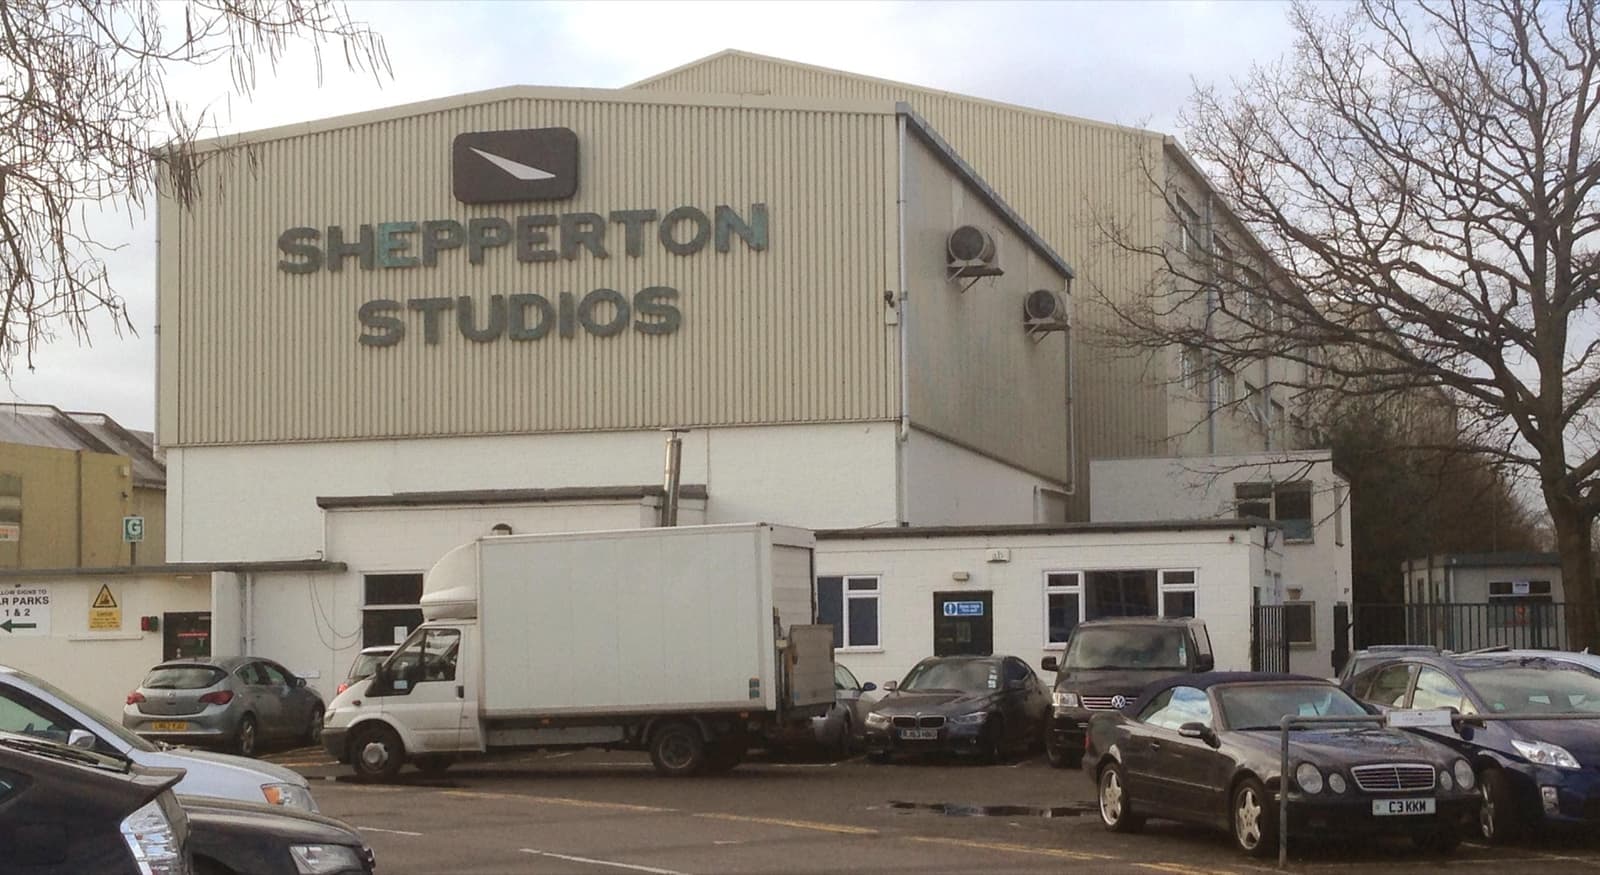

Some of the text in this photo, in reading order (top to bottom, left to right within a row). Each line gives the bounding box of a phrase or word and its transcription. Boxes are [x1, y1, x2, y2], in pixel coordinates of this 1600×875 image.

[277, 203, 769, 275] SHEPPERTON
[358, 286, 682, 347] STUDIOS
[127, 518, 142, 536] G
[0, 595, 49, 606] R PARKS
[23, 608, 31, 617] 2
[1388, 800, 1404, 813] C3
